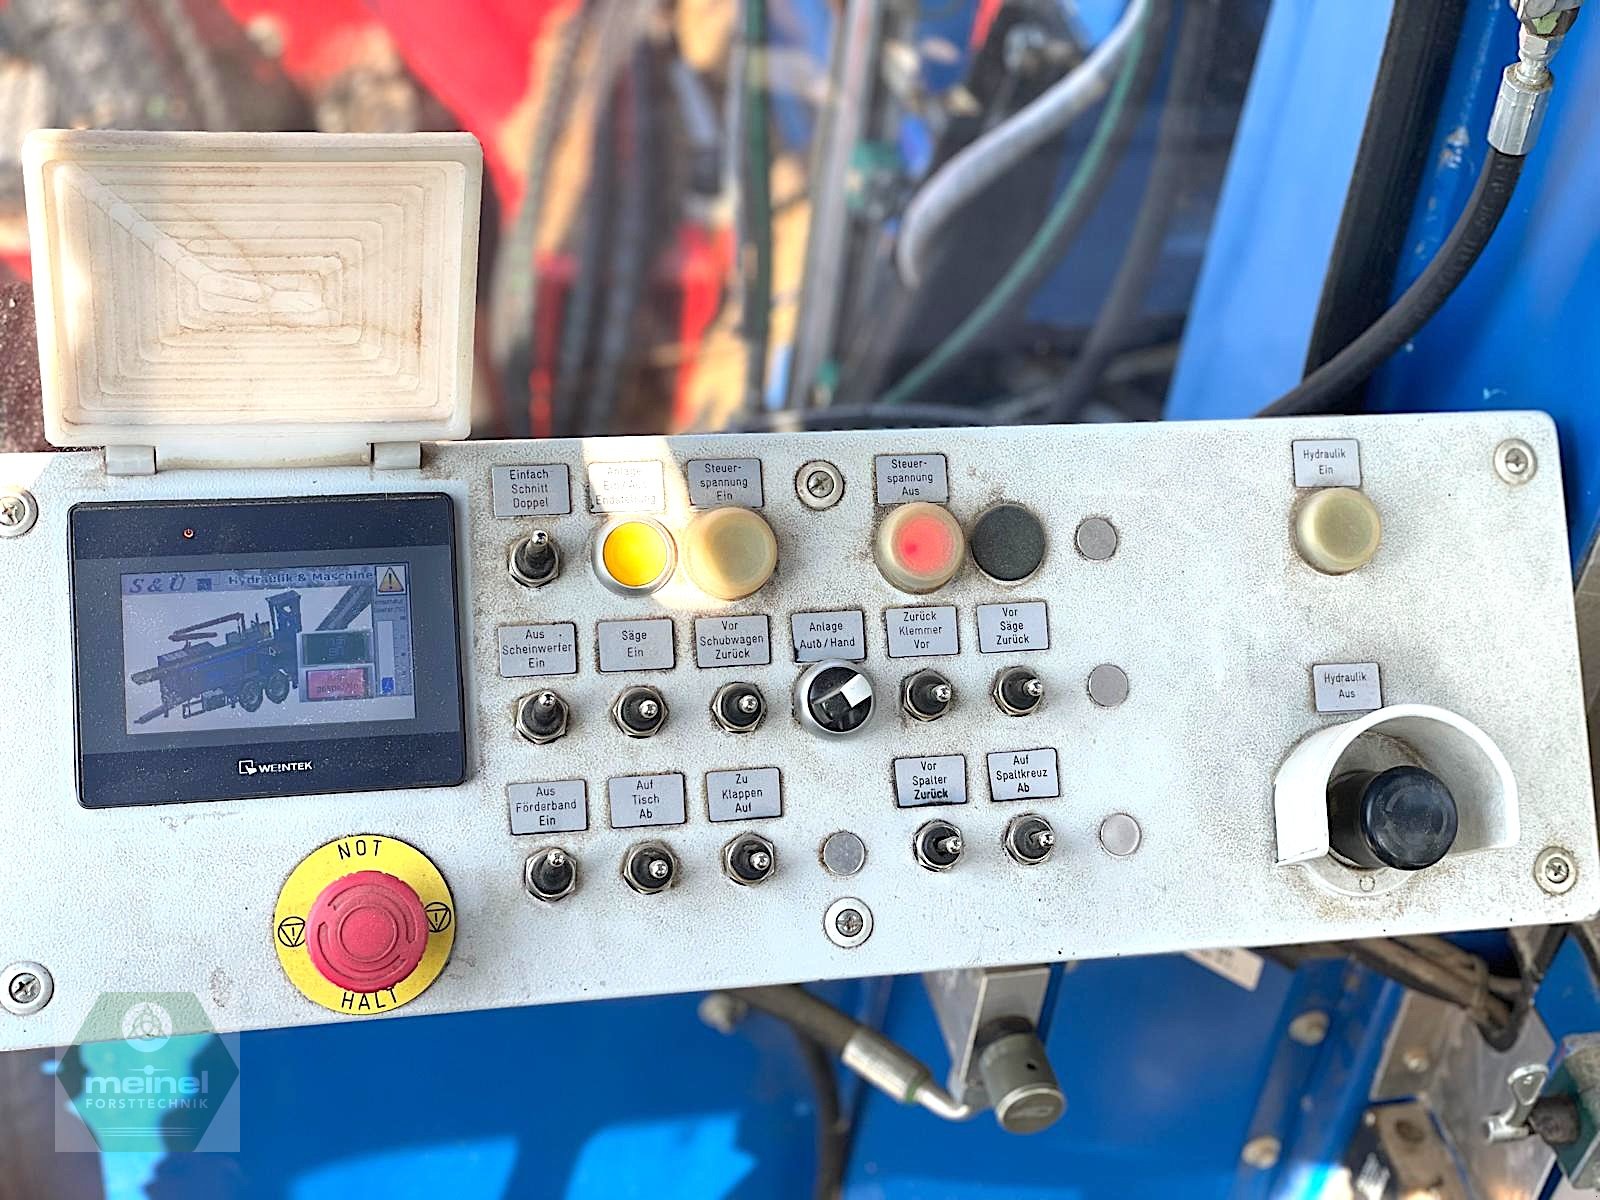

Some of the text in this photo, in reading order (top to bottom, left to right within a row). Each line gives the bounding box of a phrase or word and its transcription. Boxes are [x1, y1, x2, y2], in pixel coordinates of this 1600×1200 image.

[1303, 448, 1346, 461] Hydraulik
[704, 463, 742, 474] Steuer-
[891, 459, 927, 469] Steuer-
[509, 470, 549, 480] Einfach
[1319, 465, 1334, 475] Ein
[700, 477, 748, 488] spannung
[887, 474, 933, 485] spannung
[511, 484, 549, 494] Schnitt
[902, 486, 920, 496] Aus
[717, 491, 733, 501] Ein
[513, 498, 549, 509] Doppel
[228, 569, 373, 586] Hydraulik & Maschine
[129, 579, 144, 593] S
[903, 610, 937, 622] Zurück
[1002, 607, 1018, 618] Vor
[721, 620, 738, 631] Vor
[809, 621, 843, 633] Anlage
[899, 625, 943, 636] Klemmer
[1000, 620, 1024, 632] Säge
[525, 629, 545, 640] Aus
[621, 630, 647, 643] Säge
[996, 633, 1030, 645] Zurück
[700, 634, 764, 648] Schubwagen
[913, 639, 930, 650] Vor
[502, 642, 572, 656] Scheinwerfer
[627, 647, 644, 658] Ein
[715, 648, 751, 660] Zurück
[528, 658, 545, 669] Ein
[1324, 672, 1367, 685] Hydraulik
[1339, 689, 1356, 699] Aus
[920, 761, 937, 771] Vor
[1013, 755, 1029, 766] Auf
[258, 761, 312, 773] WEINTEK
[735, 774, 748, 785] Zu
[996, 769, 1048, 782] Spaltkreuz
[636, 780, 654, 791] Auf
[912, 776, 947, 788] Spalter
[1017, 782, 1030, 793] Ab
[535, 786, 556, 797] Aus
[721, 787, 763, 800] Klappen
[914, 788, 949, 800] Zurück
[632, 793, 660, 805] Tisch
[516, 799, 577, 812] Förderband
[734, 803, 751, 814] Auf
[639, 808, 653, 819] Ab
[539, 815, 556, 826] Ein
[338, 840, 382, 860] NOT
[341, 987, 397, 1010] HALT
